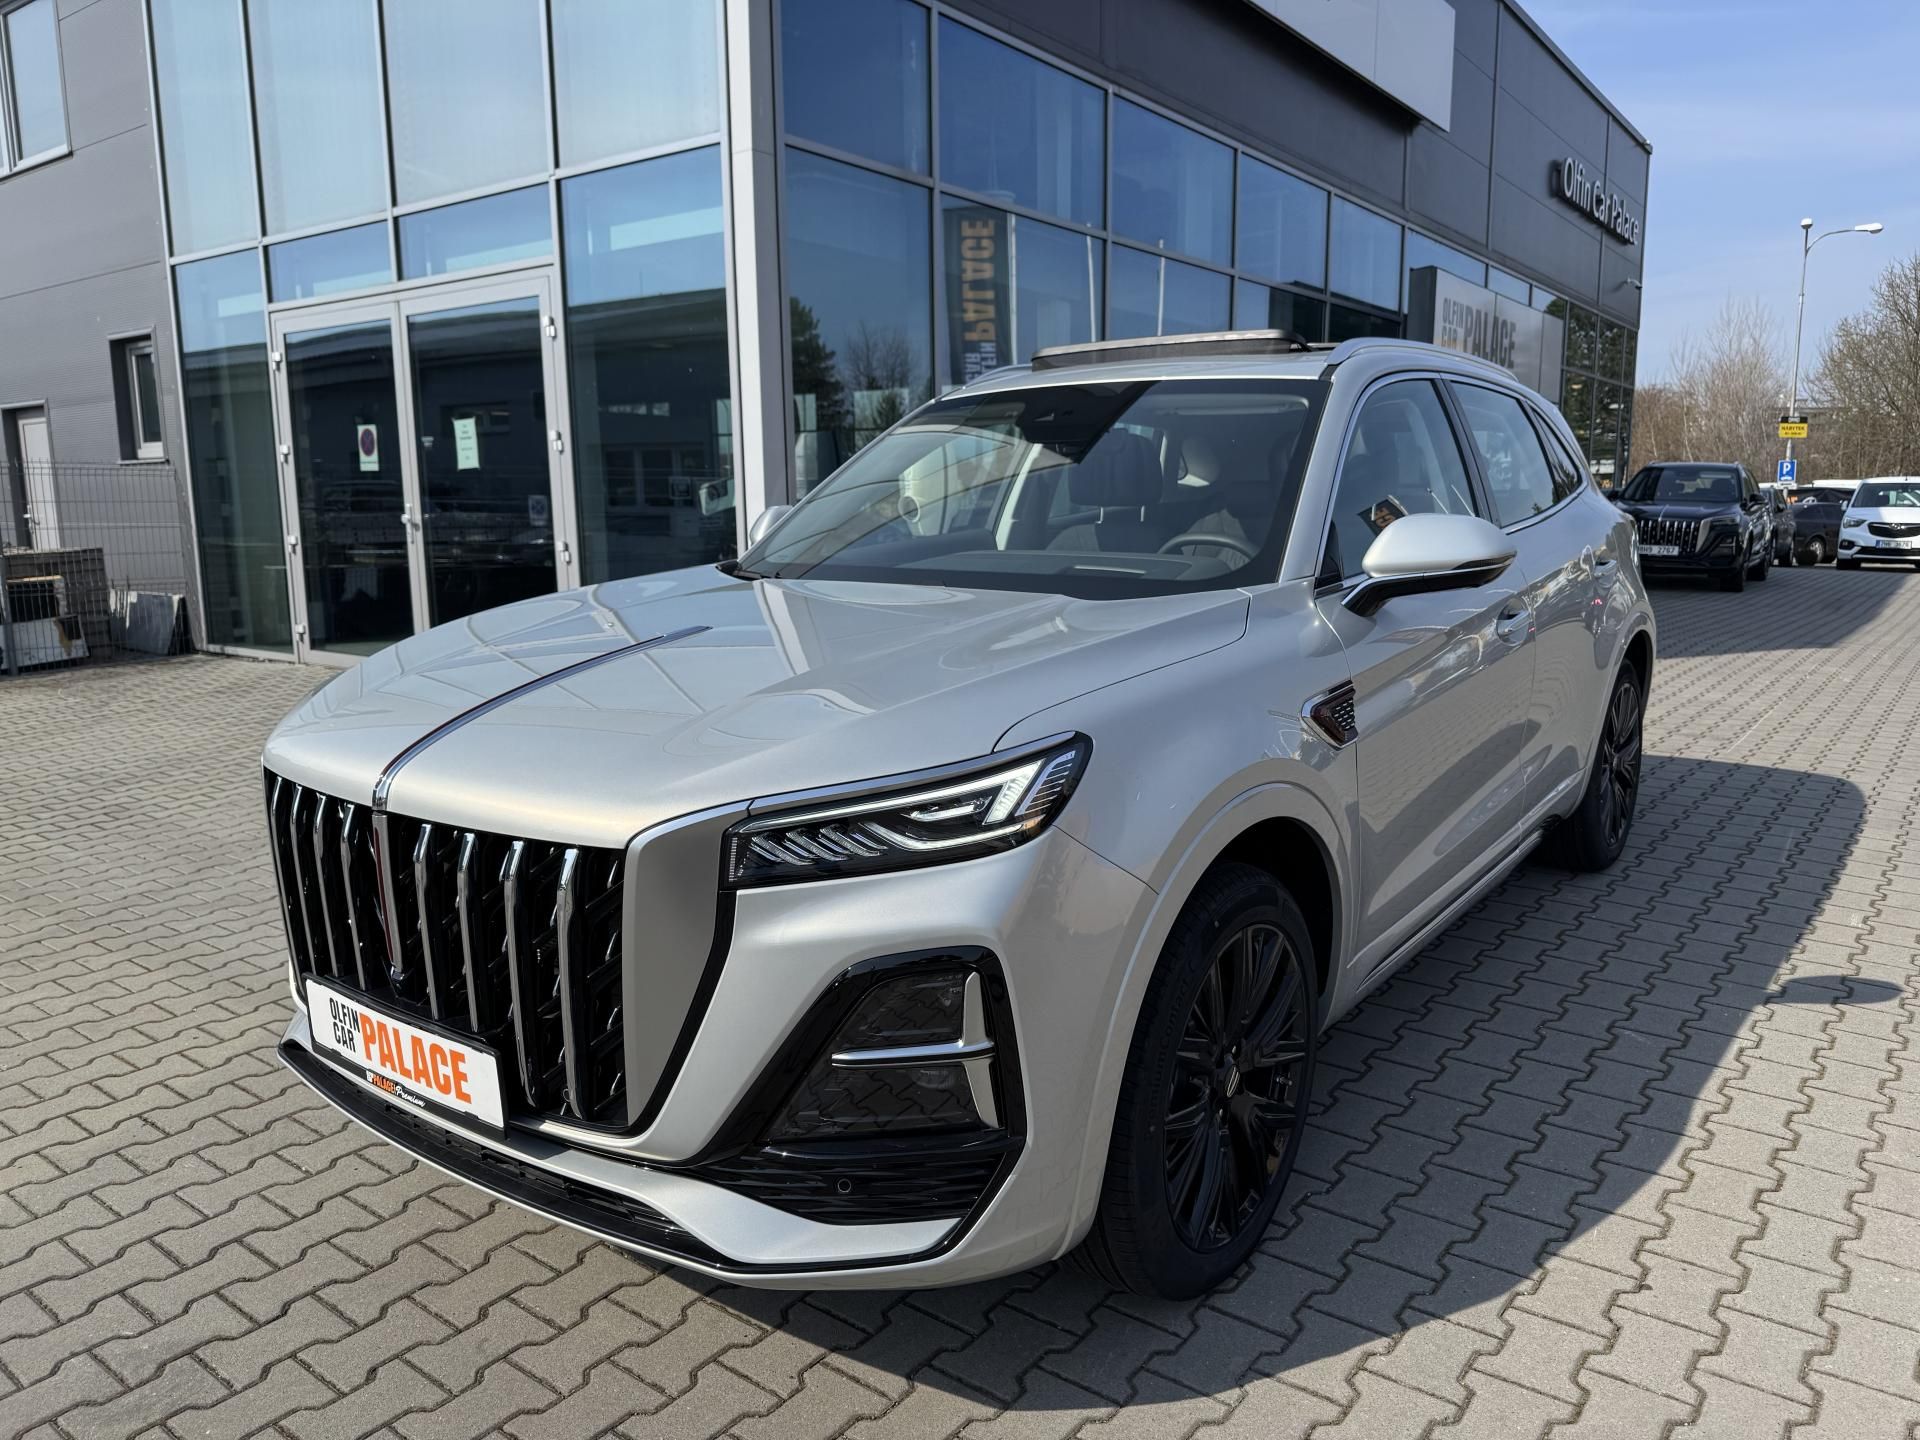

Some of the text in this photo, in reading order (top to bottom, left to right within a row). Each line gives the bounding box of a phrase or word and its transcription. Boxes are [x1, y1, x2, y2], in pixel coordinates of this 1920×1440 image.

[1563, 157, 1639, 245] Olfin Car Palace
[1442, 297, 1465, 329] OLFIN
[1463, 305, 1517, 369] PALACE
[1783, 462, 1791, 475] P
[330, 997, 360, 1034] OLFIN
[333, 1022, 357, 1053] CAR
[359, 1012, 472, 1104] PALACE
